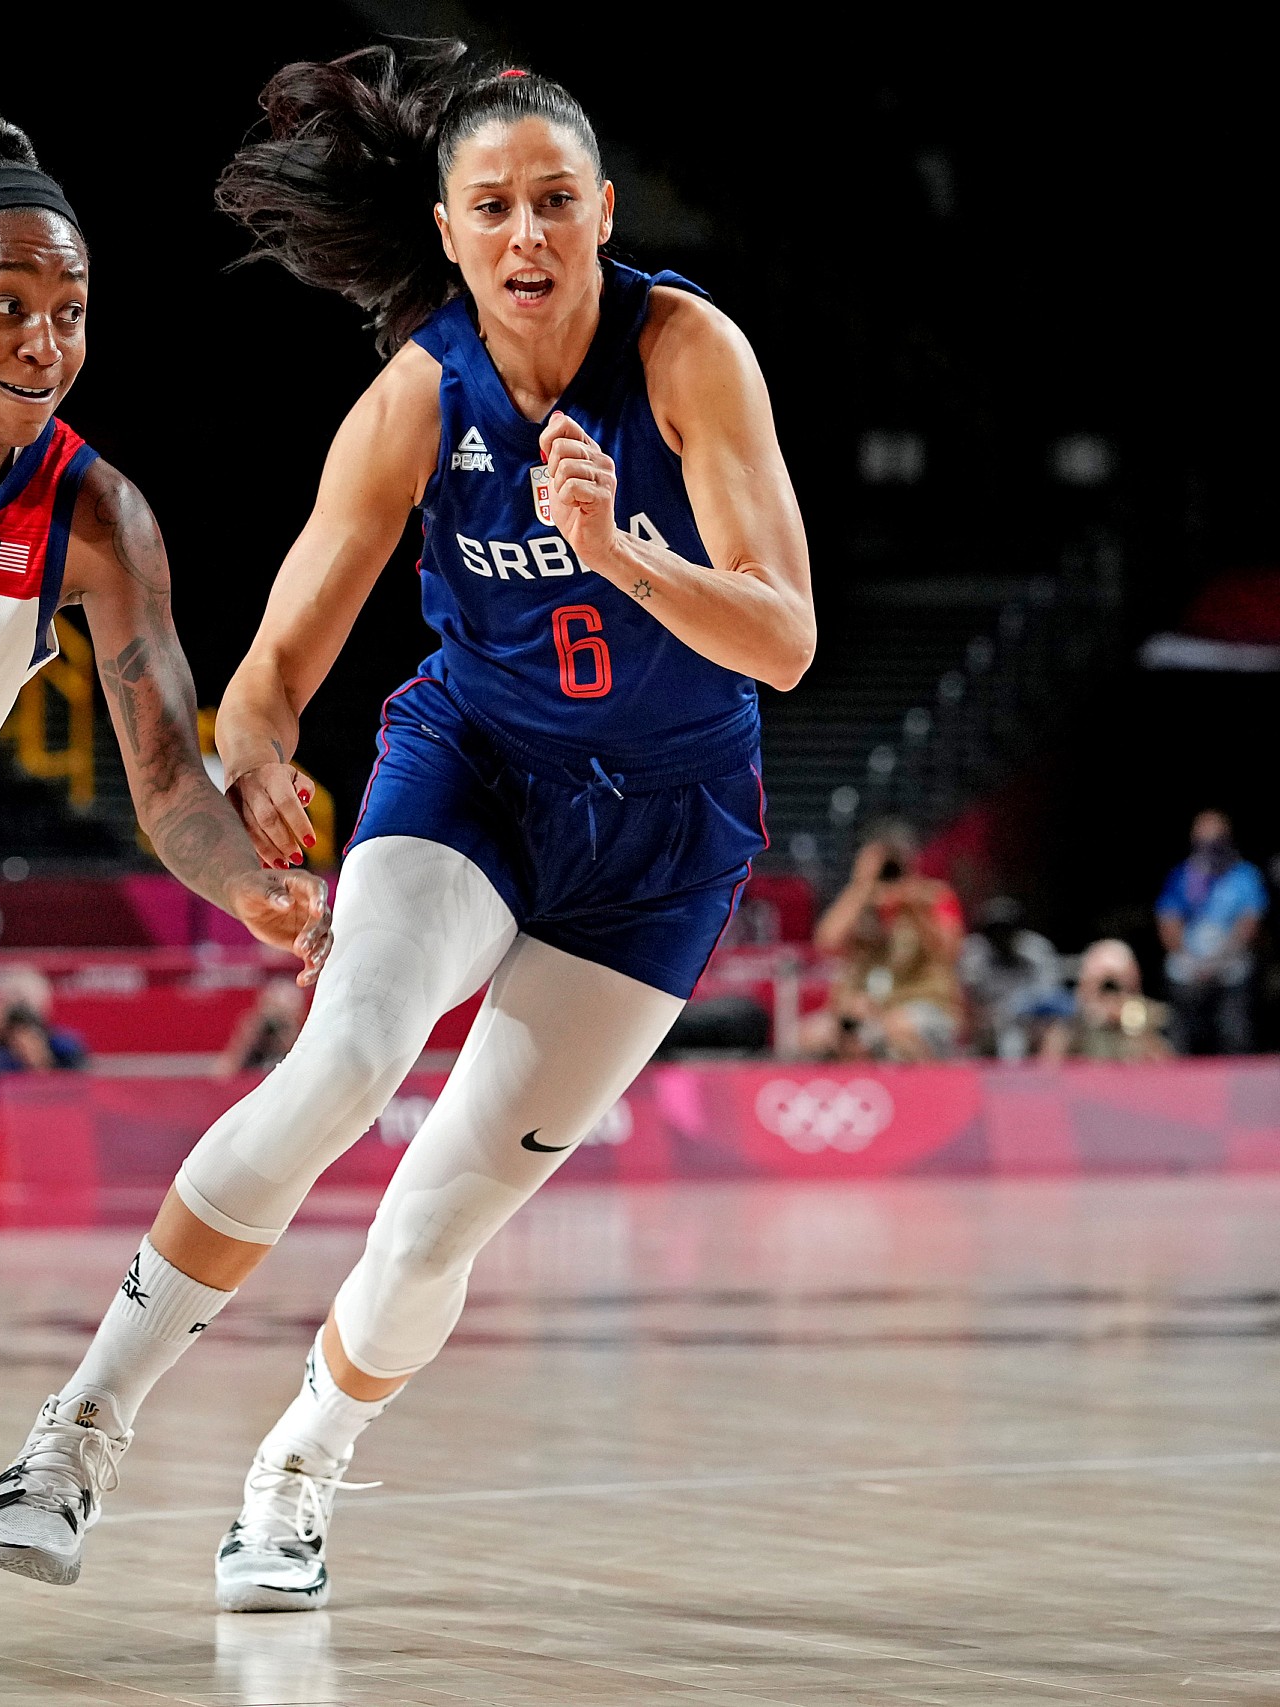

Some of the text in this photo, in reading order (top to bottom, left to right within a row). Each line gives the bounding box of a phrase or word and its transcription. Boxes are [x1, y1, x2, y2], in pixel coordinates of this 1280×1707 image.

[451, 452, 494, 472] PEAK
[456, 512, 669, 580] SRBA
[552, 604, 612, 698] 6
